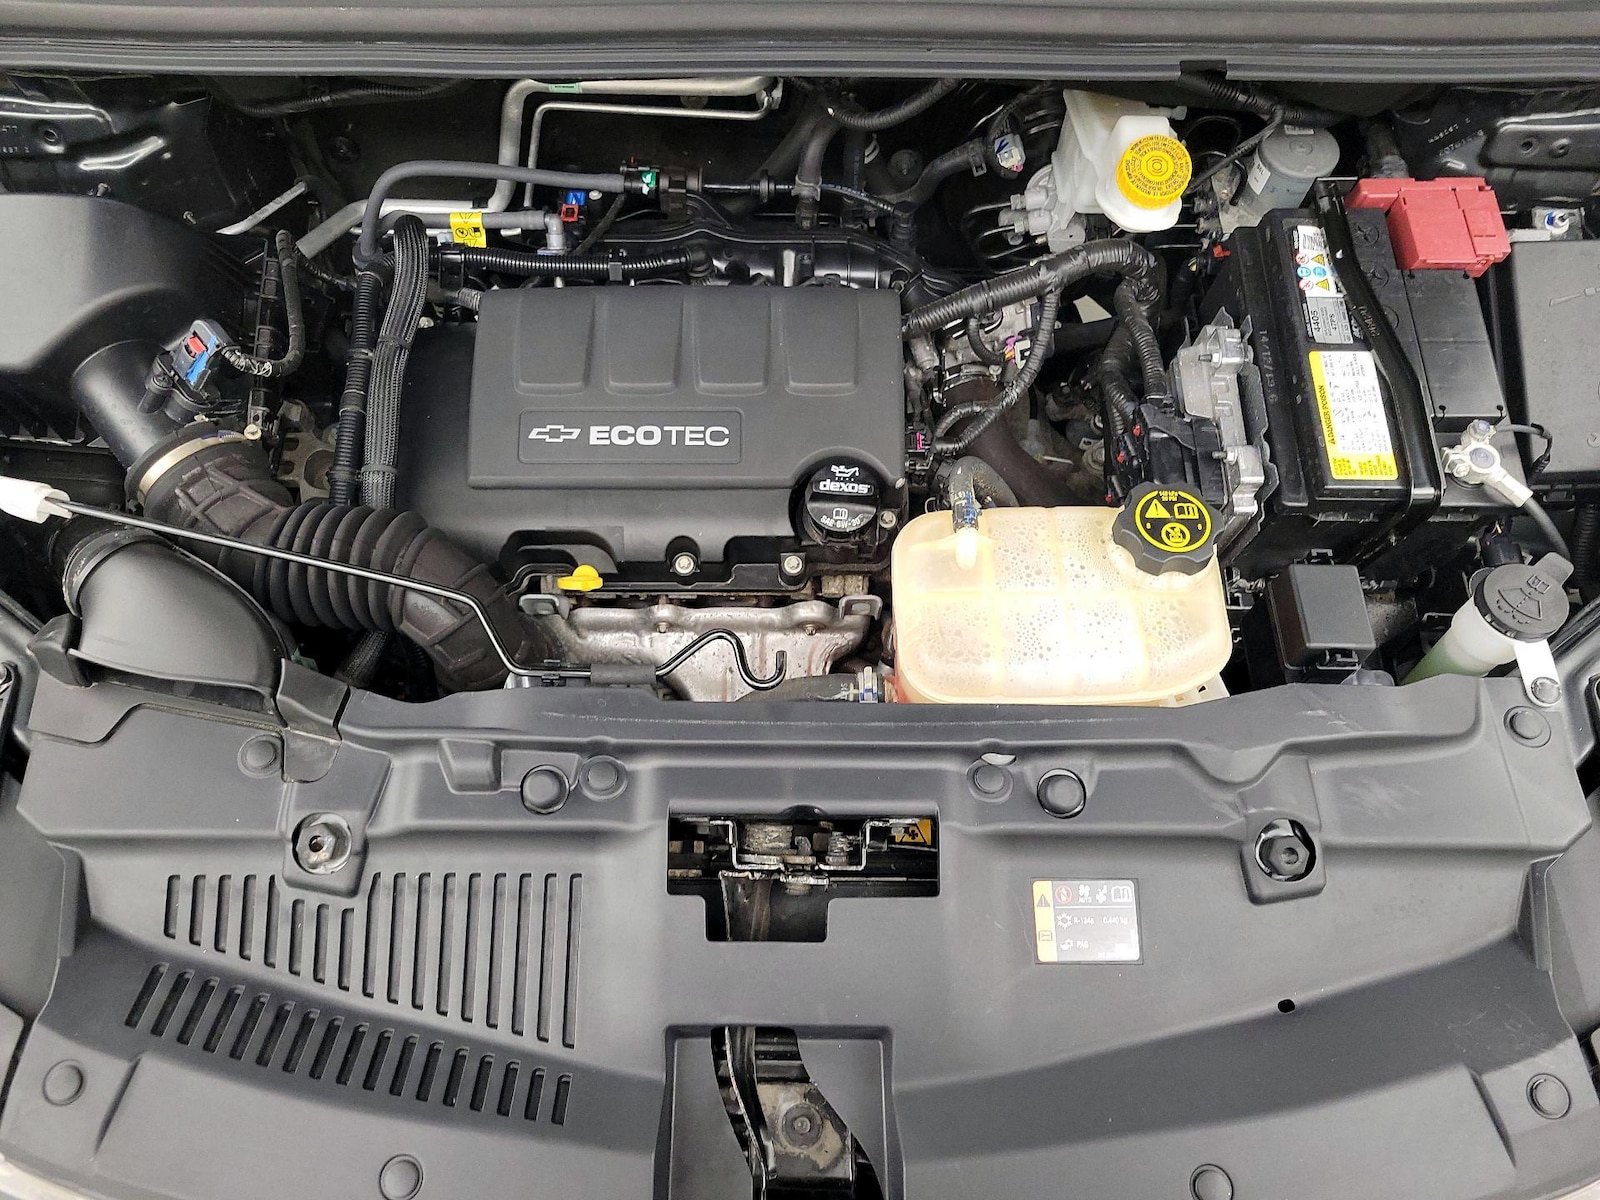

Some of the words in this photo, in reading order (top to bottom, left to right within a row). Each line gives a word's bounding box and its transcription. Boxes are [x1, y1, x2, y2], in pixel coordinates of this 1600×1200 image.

[1318, 385, 1329, 410] POISON
[1323, 410, 1335, 438] DANGER
[589, 425, 730, 447] ECOTEC
[819, 479, 870, 493] dexos
[820, 515, 834, 527] SAE
